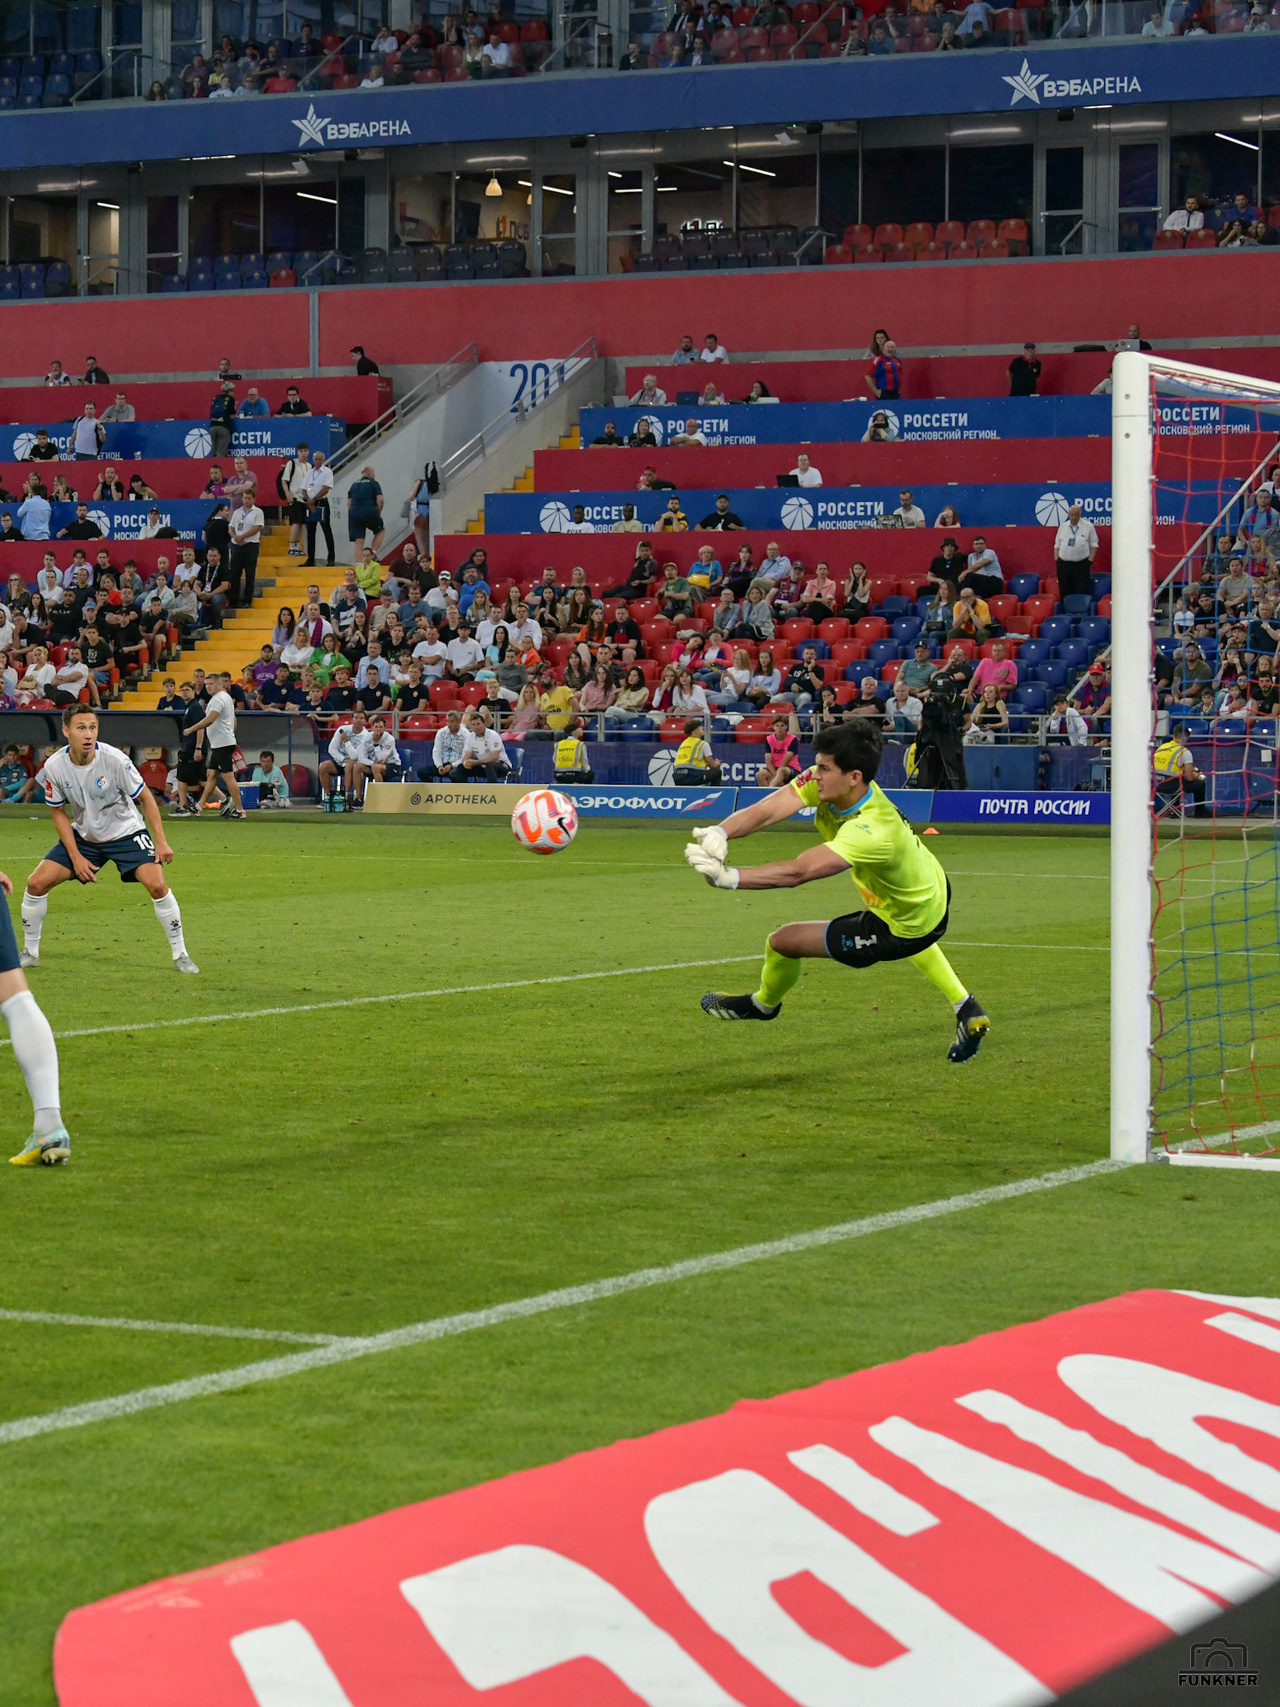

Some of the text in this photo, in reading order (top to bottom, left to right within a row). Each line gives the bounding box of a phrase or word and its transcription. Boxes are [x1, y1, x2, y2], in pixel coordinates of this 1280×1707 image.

[1043, 76, 1142, 98] ВЭБАРЕНА
[327, 119, 411, 140] ВЭБАРЕНА
[904, 413, 968, 428] РОССЕТИ
[1152, 407, 1220, 422] РОССЕТИ
[667, 419, 729, 433] РОСЕТИ
[232, 431, 271, 445] ССЕТИ
[724, 435, 756, 445] РЕГИОН
[904, 429, 997, 441] МОСКОВСКИЙ РЕГИОН
[98, 451, 120, 460] ЕГИОН
[227, 446, 296, 457] СКОВСКИЙ РЕГИОН
[818, 501, 884, 516] РОССЕТИ
[1074, 498, 1112, 512] РОСС
[114, 514, 171, 527] РОССИ
[424, 794, 497, 805] APOTHEKA
[979, 799, 1091, 815] ПОЧТА РОССИИ
[133, 834, 155, 850] 10
